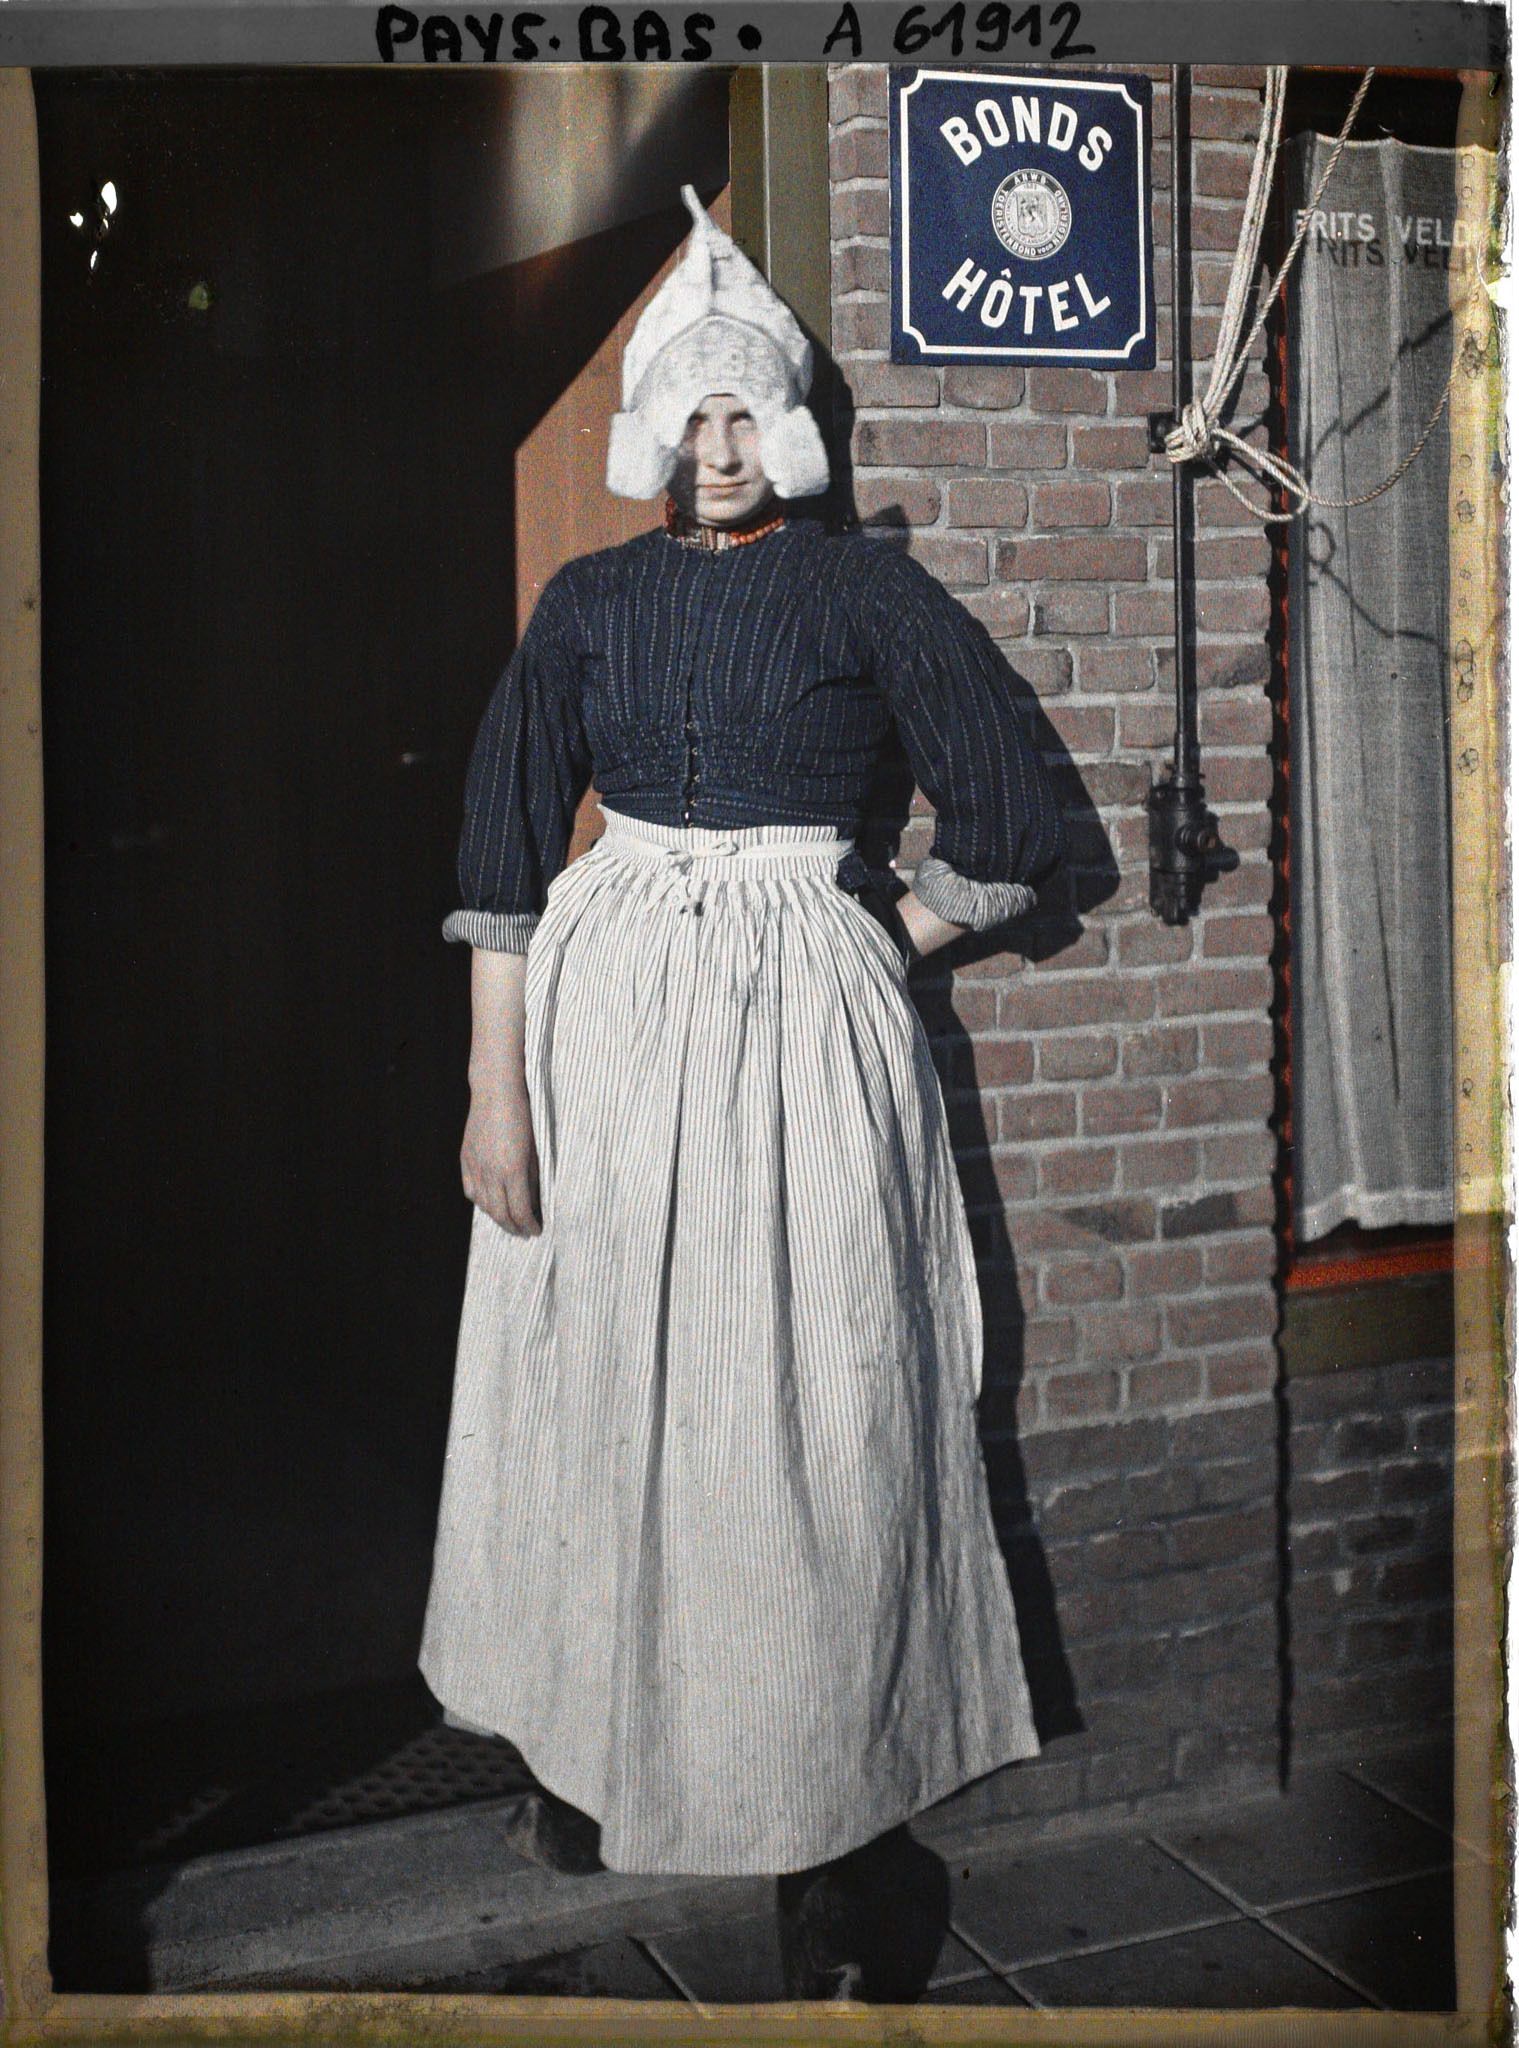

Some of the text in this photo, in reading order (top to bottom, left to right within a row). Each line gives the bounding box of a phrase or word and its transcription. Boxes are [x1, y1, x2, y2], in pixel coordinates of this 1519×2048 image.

[822, 2, 863, 58] A
[892, 2, 1097, 61] 61912
[939, 95, 1113, 172] BONDS
[941, 257, 1112, 335] HÔTEL
